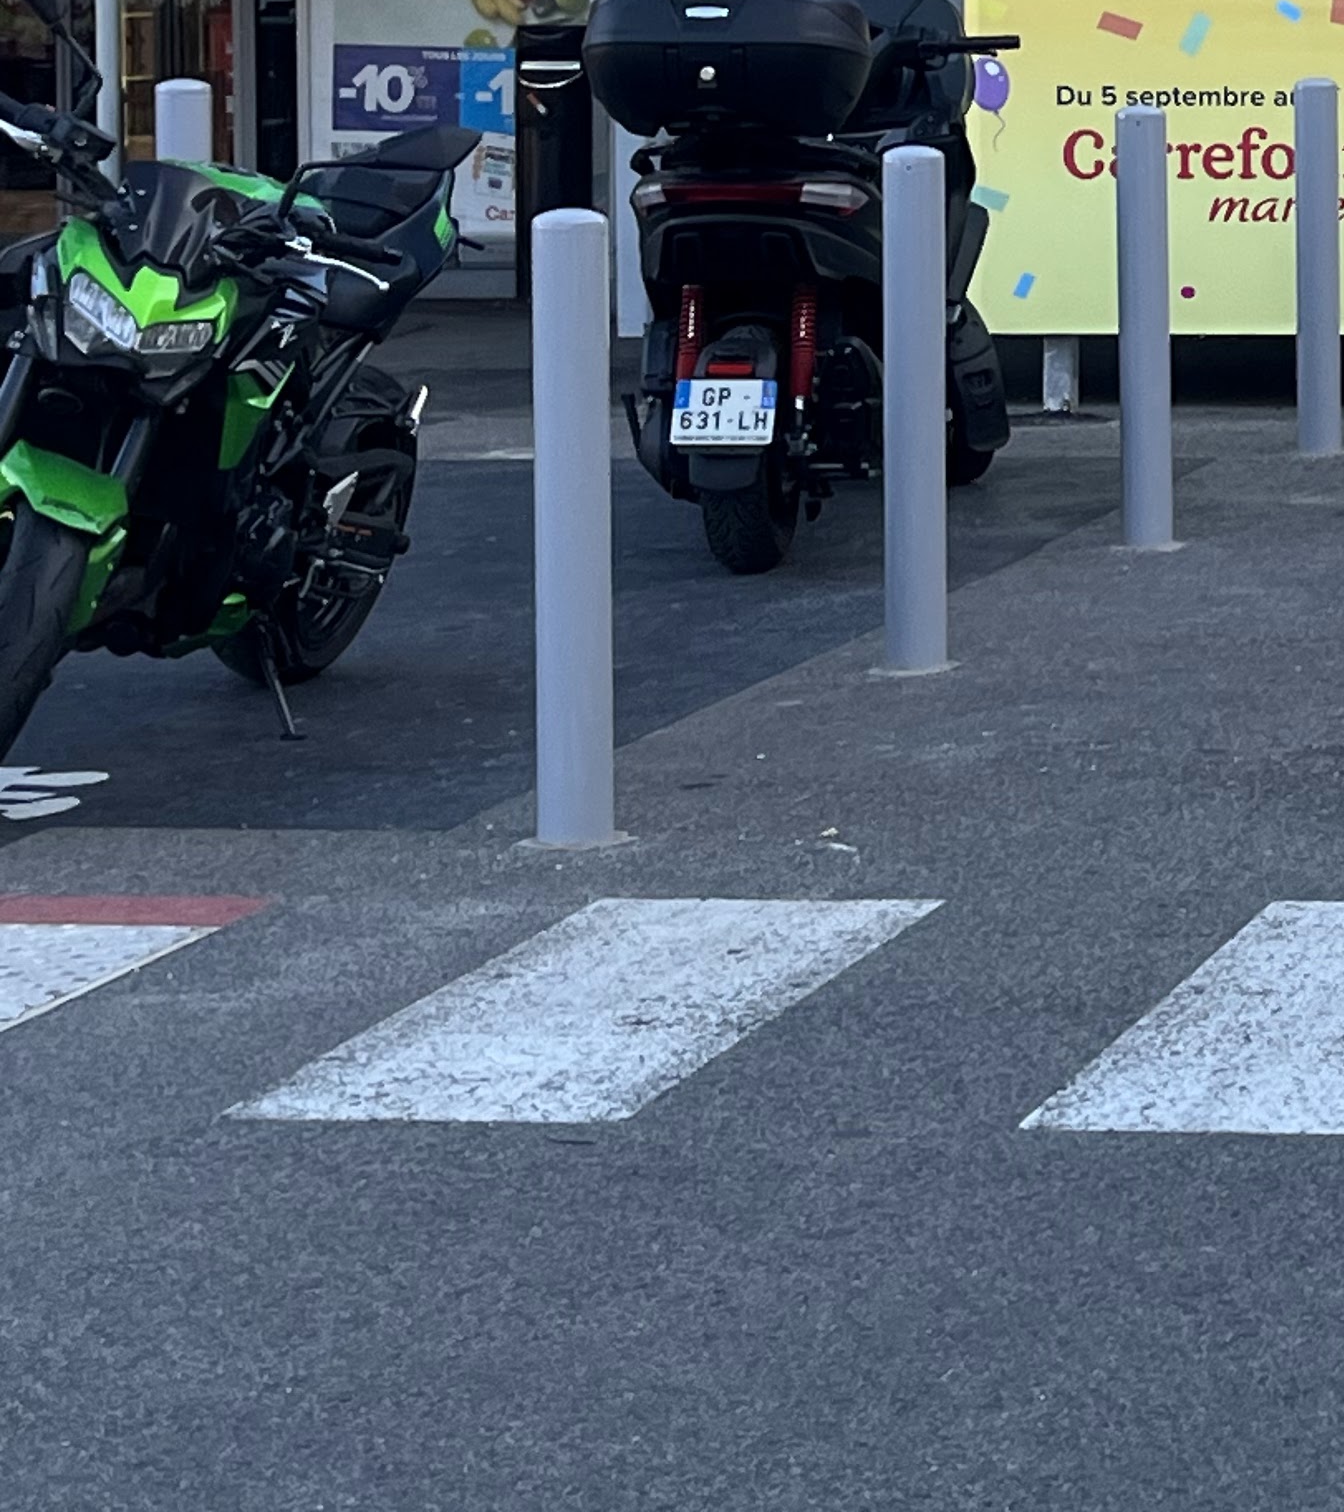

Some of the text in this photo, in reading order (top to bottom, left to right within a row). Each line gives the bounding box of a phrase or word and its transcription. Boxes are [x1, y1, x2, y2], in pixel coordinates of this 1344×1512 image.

[1056, 85, 1092, 106] Du
[1101, 85, 1117, 106] 5
[1126, 85, 1265, 112] septembre
